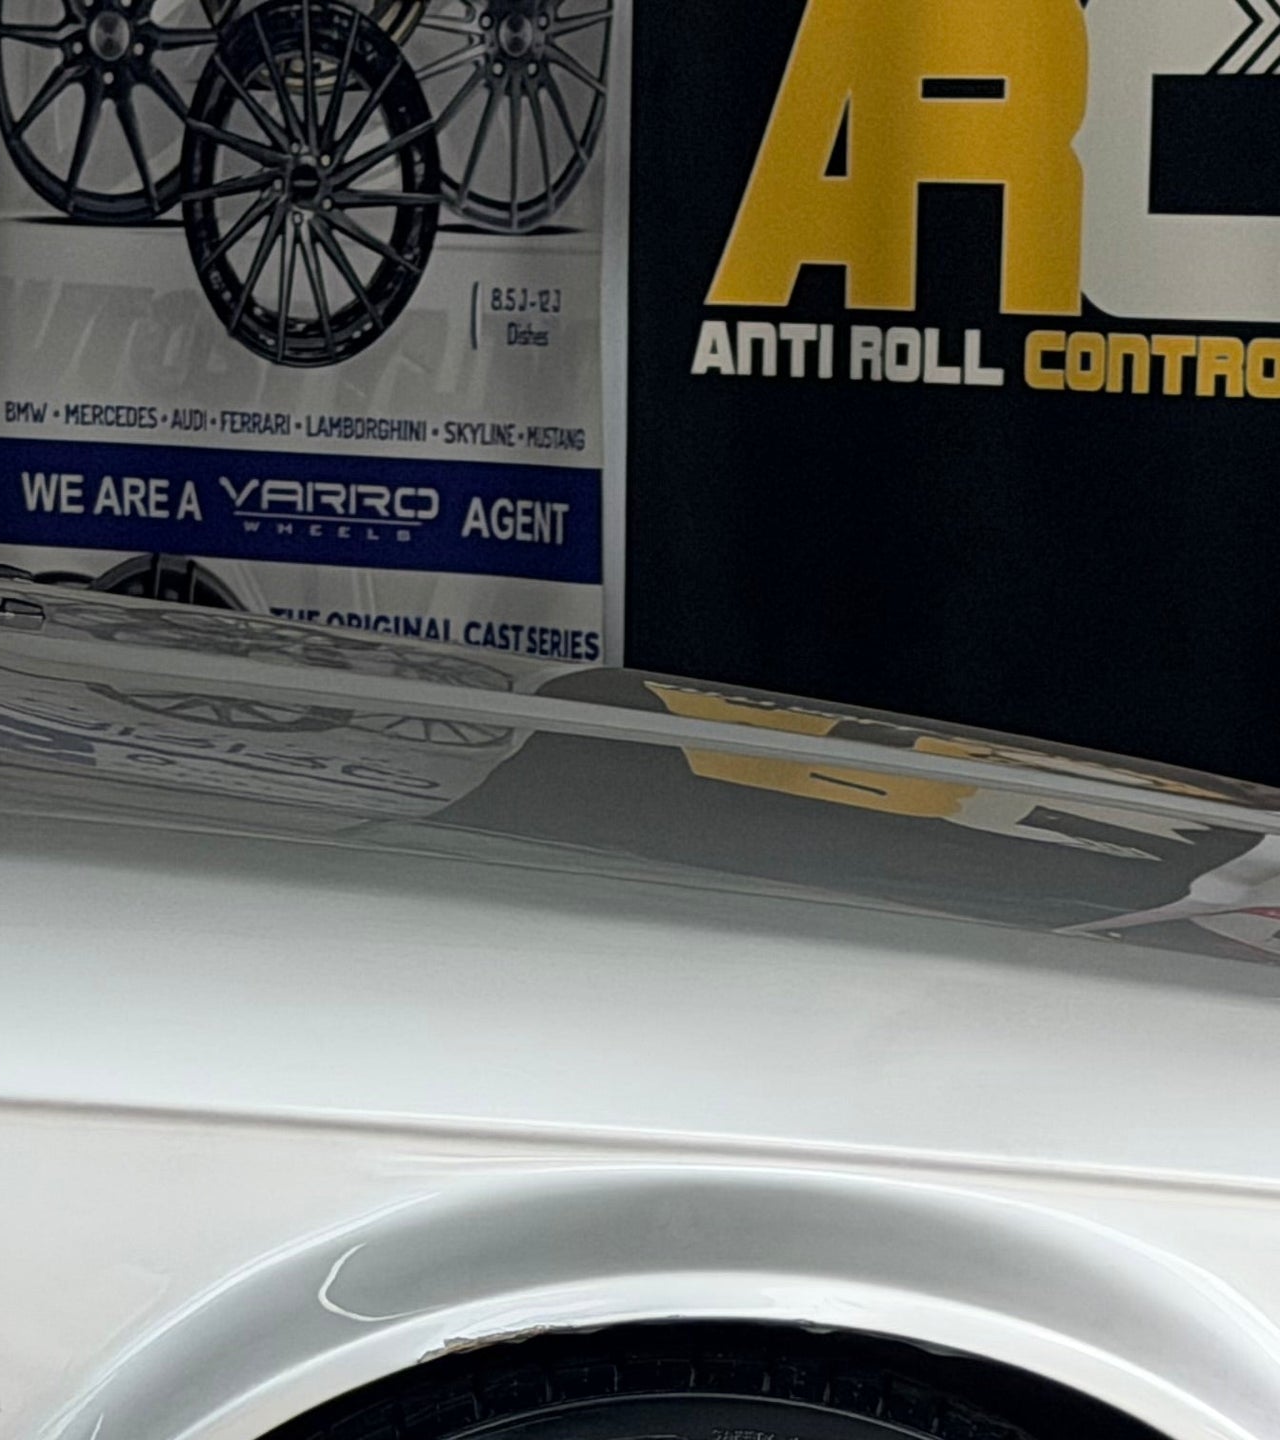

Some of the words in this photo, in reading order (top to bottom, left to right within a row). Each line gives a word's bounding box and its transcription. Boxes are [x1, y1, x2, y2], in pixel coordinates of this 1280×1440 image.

[690, 319, 833, 379] ANTI
[850, 325, 1004, 387] ROLL
[5, 400, 47, 424] BMW
[64, 402, 158, 429] MERCEDES
[171, 407, 208, 432] AUDI
[220, 410, 291, 436] FERRARI
[305, 414, 427, 443] LAMBORGHINI
[443, 420, 516, 448] SKYLINE
[526, 426, 586, 451] MUSTANG
[21, 471, 85, 515] WE
[92, 475, 170, 519] ARE
[175, 479, 203, 522] A
[461, 496, 569, 546] AGENT
[463, 620, 525, 652] CAST
[526, 625, 600, 662] SERIES
